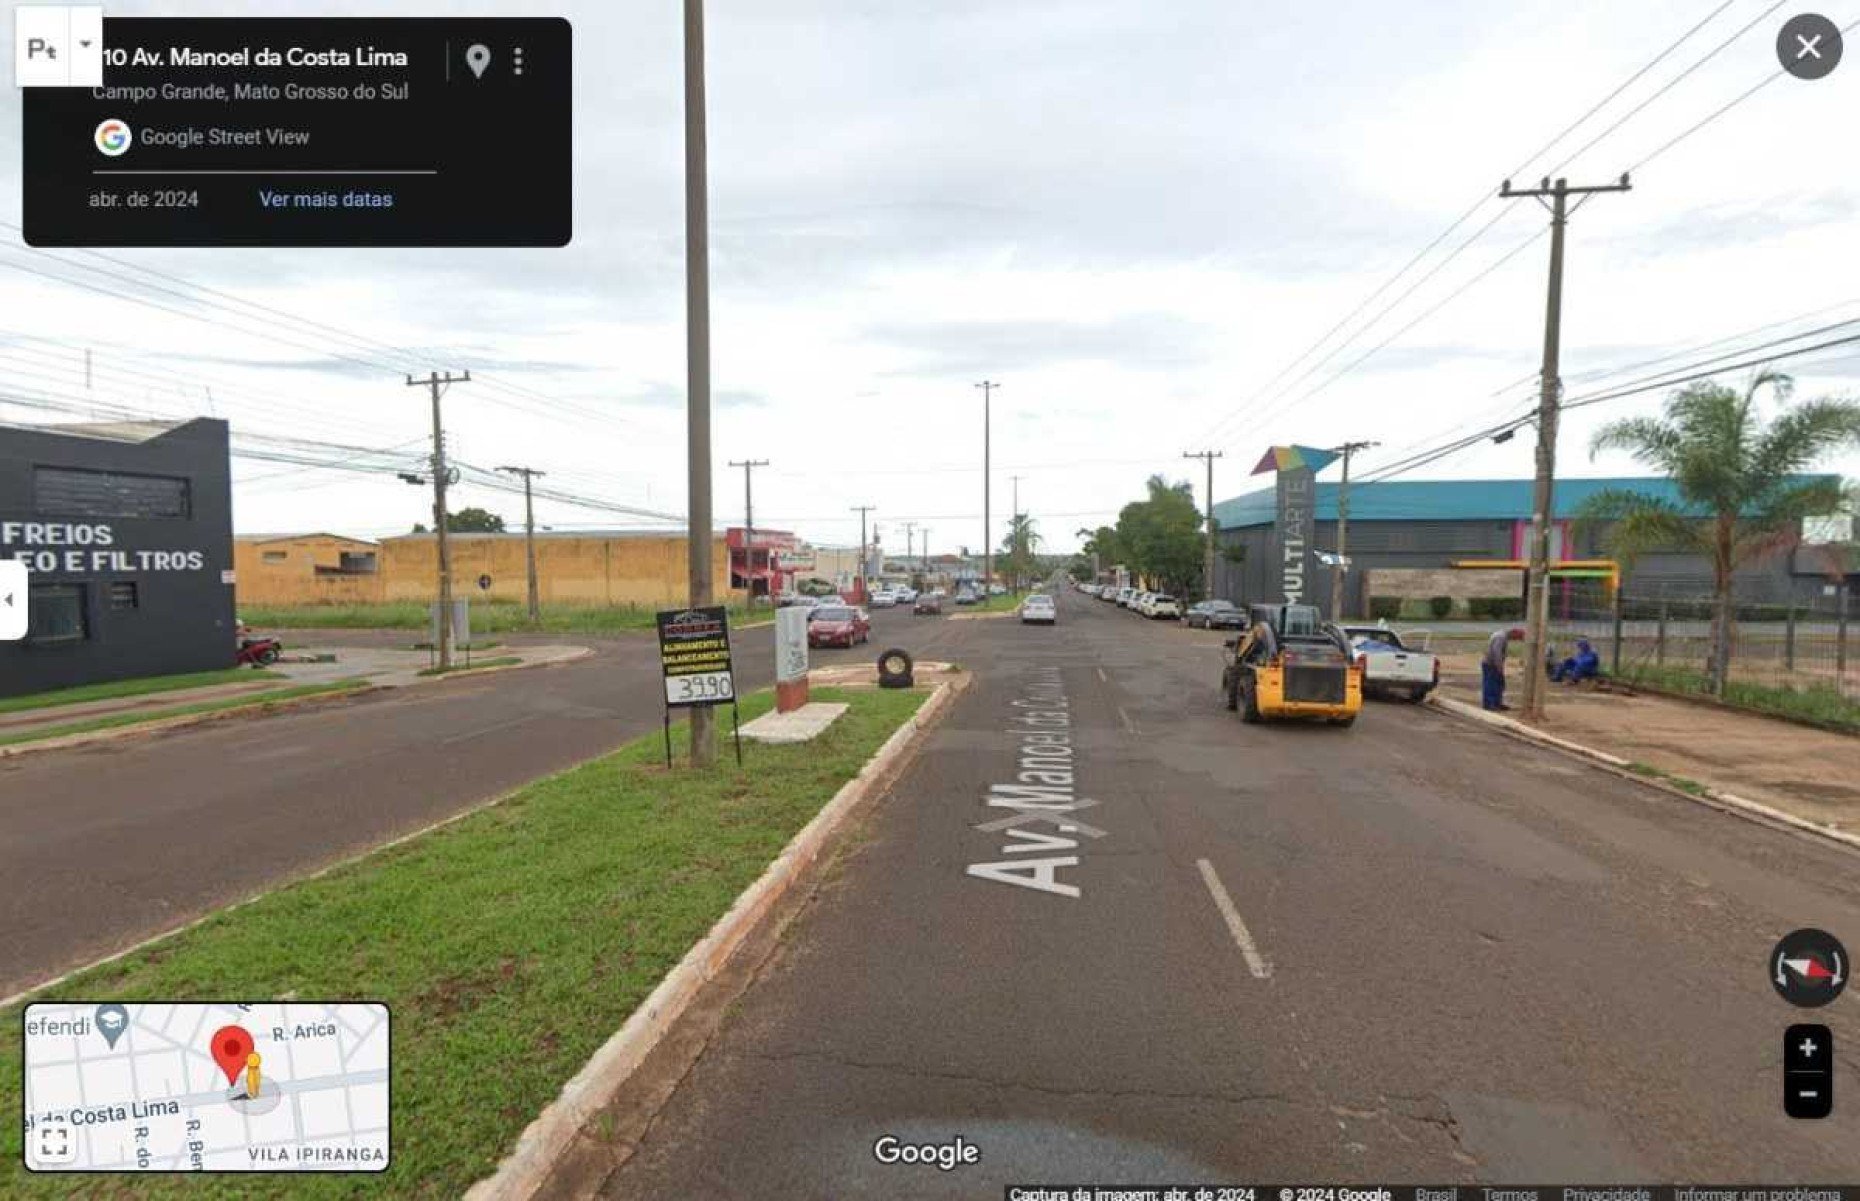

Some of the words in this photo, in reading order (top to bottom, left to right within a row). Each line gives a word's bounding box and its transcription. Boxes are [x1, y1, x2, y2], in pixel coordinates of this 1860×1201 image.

[2, 521, 113, 545] FREIOS
[65, 551, 85, 572] E
[92, 551, 204, 572] FILTROS
